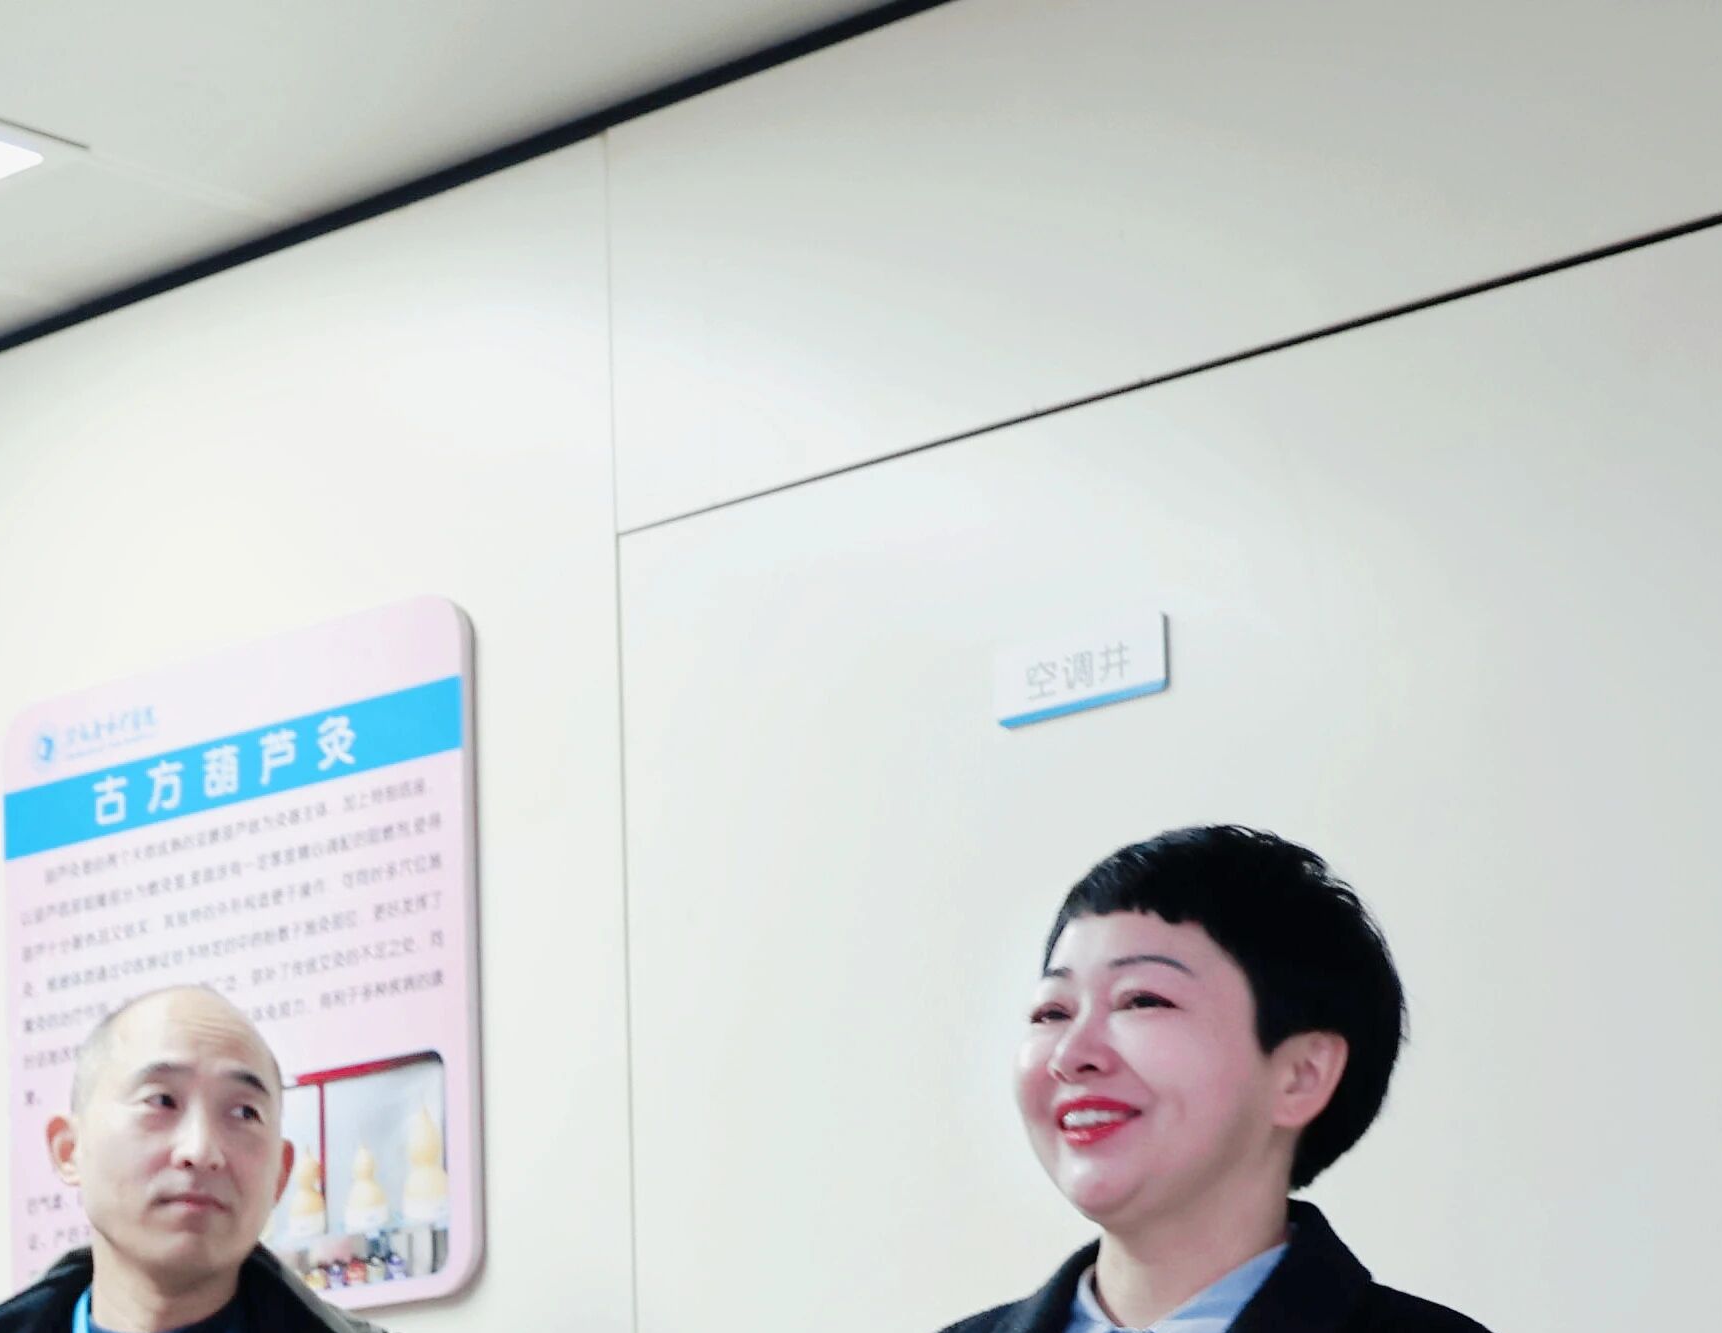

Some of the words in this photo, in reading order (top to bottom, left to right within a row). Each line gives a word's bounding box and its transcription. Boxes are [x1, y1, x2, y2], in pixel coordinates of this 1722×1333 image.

[1024, 640, 1131, 700] 空调井
[93, 715, 358, 826] 古方葫芦灸
